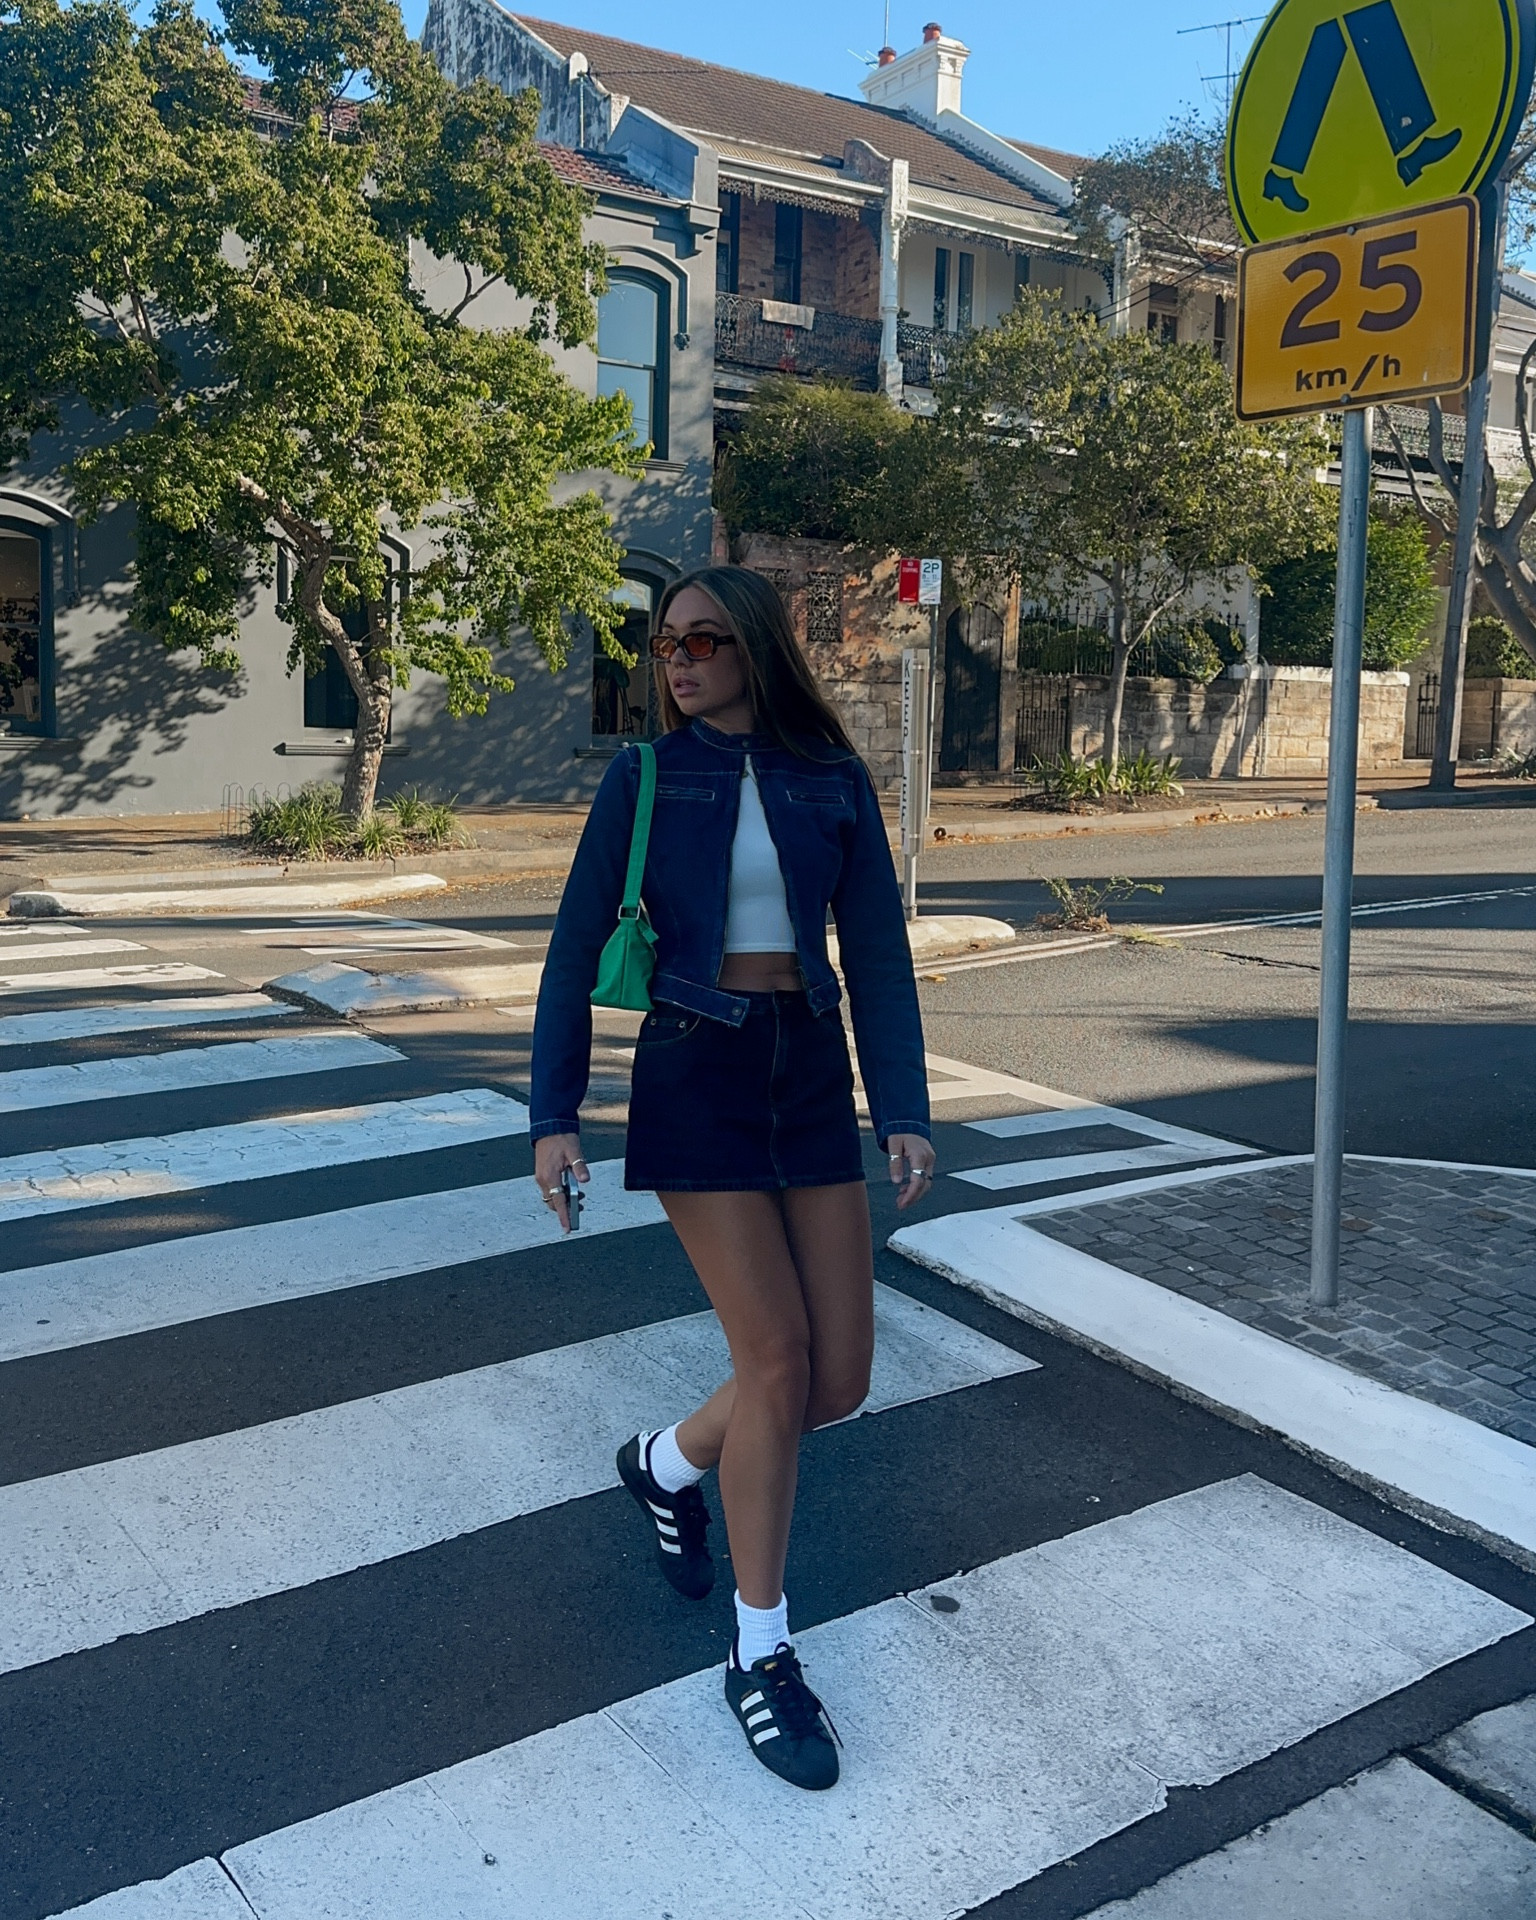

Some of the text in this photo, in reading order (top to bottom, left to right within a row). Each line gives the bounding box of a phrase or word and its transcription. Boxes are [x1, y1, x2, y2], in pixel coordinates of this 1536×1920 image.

[1280, 230, 1422, 349] 25
[1296, 354, 1401, 392] km/h
[923, 562, 940, 573] 2P
